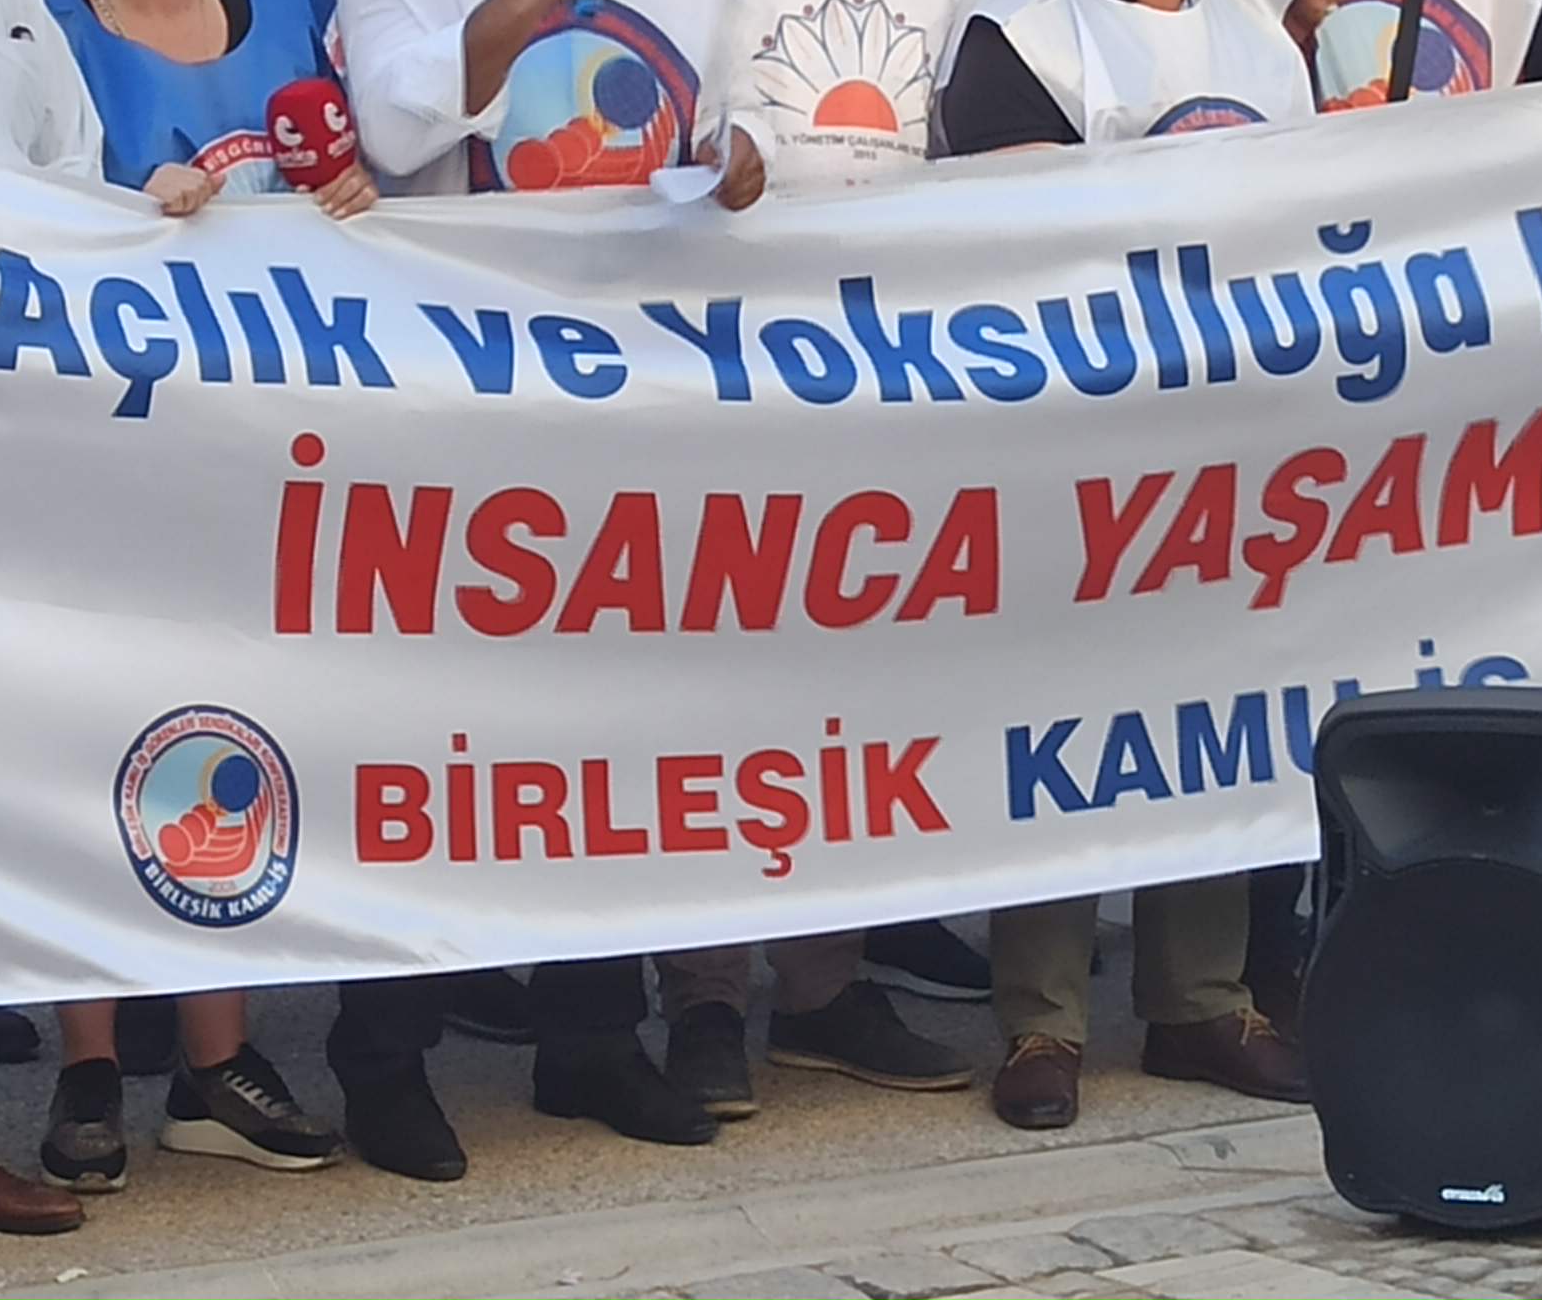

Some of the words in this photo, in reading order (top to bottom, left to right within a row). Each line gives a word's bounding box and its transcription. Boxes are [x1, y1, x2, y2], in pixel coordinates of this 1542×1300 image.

[420, 301, 628, 401] ve
[639, 220, 1493, 404] Yoksulluğa
[272, 432, 1001, 636] İNSANCA
[352, 717, 952, 878] BİRLEŞİK
[143, 862, 223, 919] BİRLEŞİK
